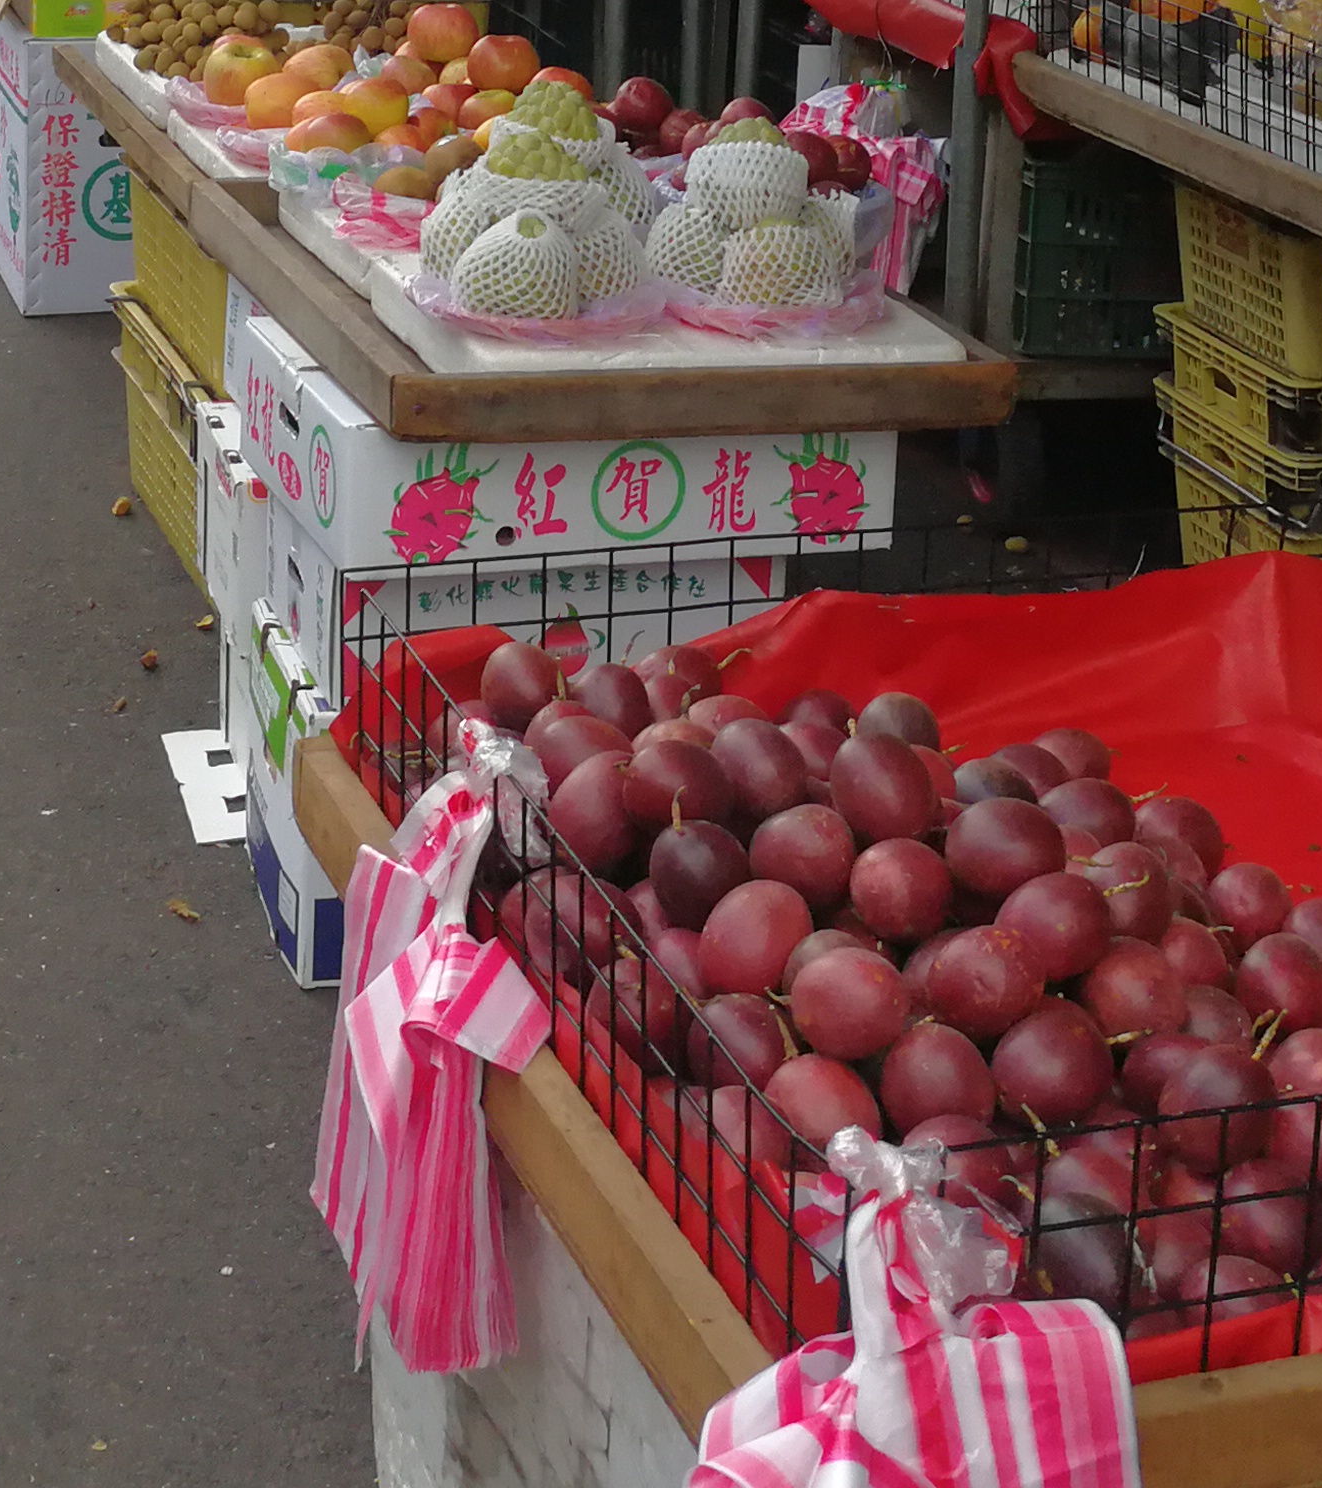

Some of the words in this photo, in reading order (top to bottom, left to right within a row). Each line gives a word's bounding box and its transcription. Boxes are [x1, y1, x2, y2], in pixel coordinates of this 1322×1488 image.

[41, 113, 80, 267] 保證特清
[314, 440, 330, 516] 賀
